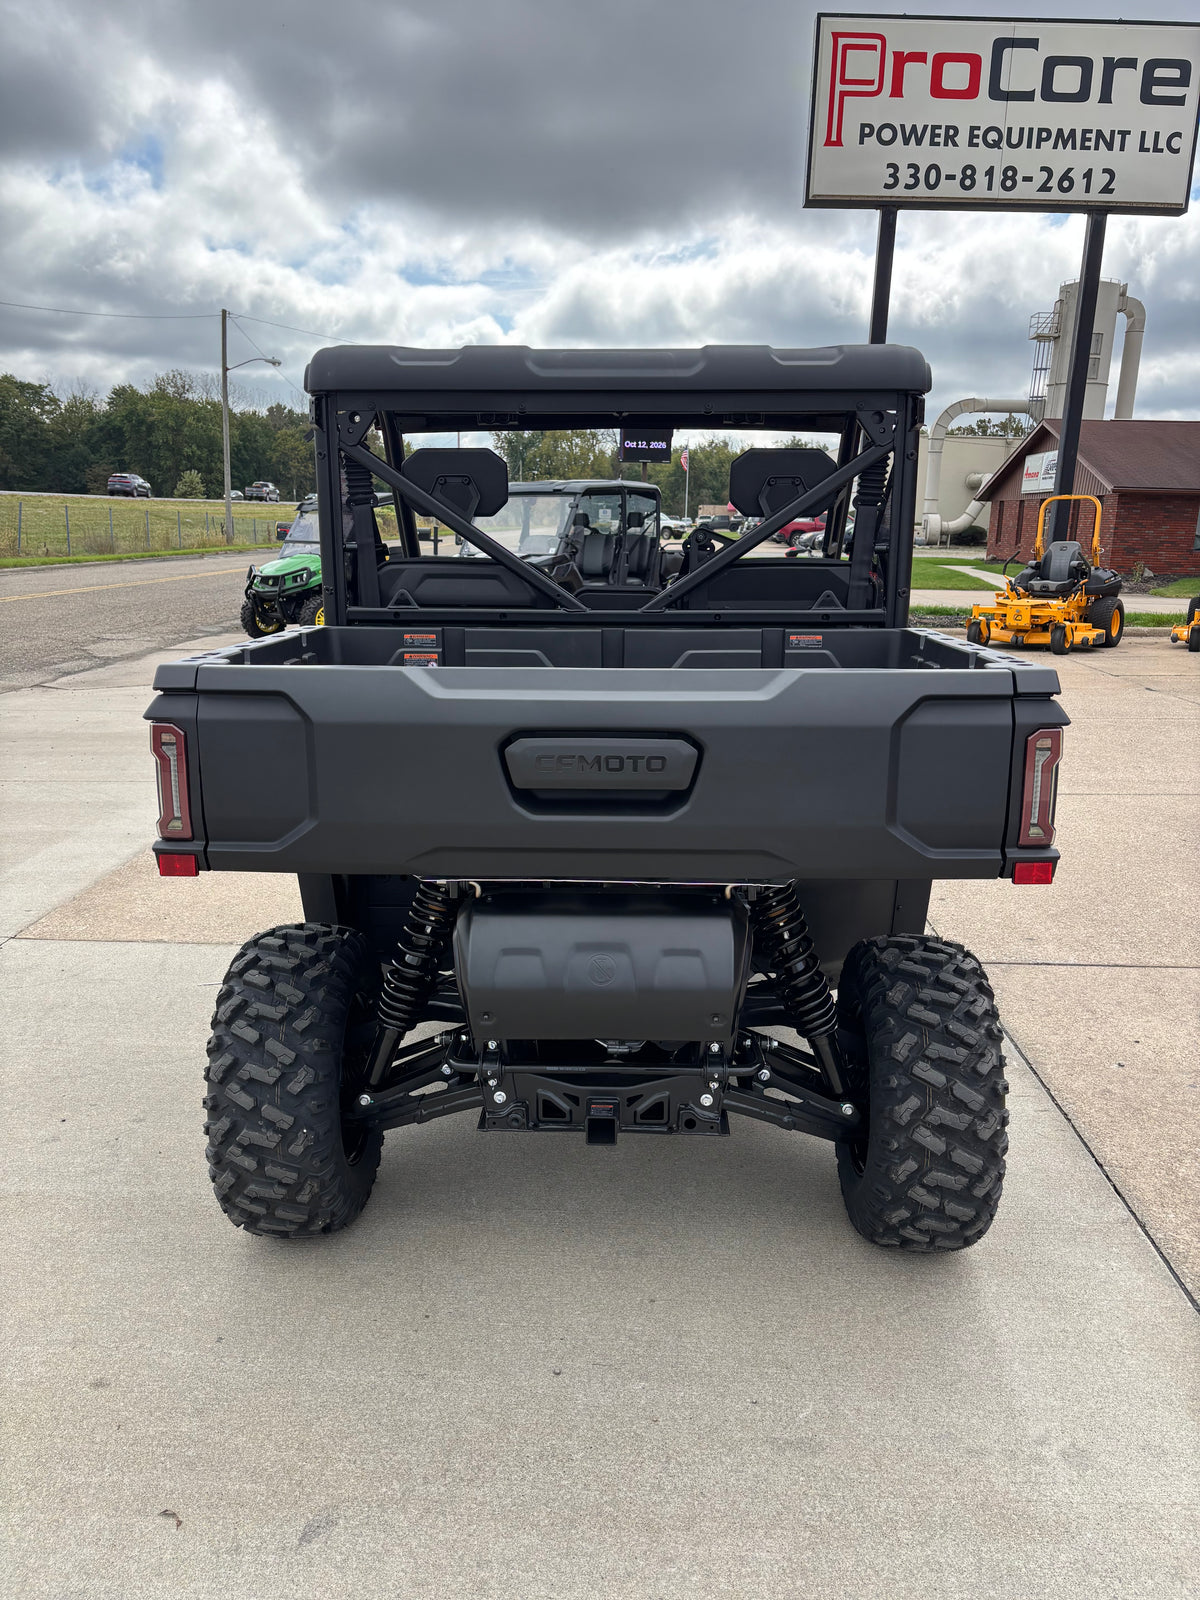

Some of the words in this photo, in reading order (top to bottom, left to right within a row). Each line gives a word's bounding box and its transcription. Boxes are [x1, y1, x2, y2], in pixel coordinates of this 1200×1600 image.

[823, 31, 1193, 147] ProCore
[858, 122, 960, 148] POWER
[967, 125, 1132, 152] EQUIPMENT
[1138, 130, 1184, 155] LLC
[883, 162, 1116, 195] 330-818-2612
[624, 440, 637, 448] Oct
[638, 441, 648, 449] 12,
[534, 754, 668, 773] CFMOTO
